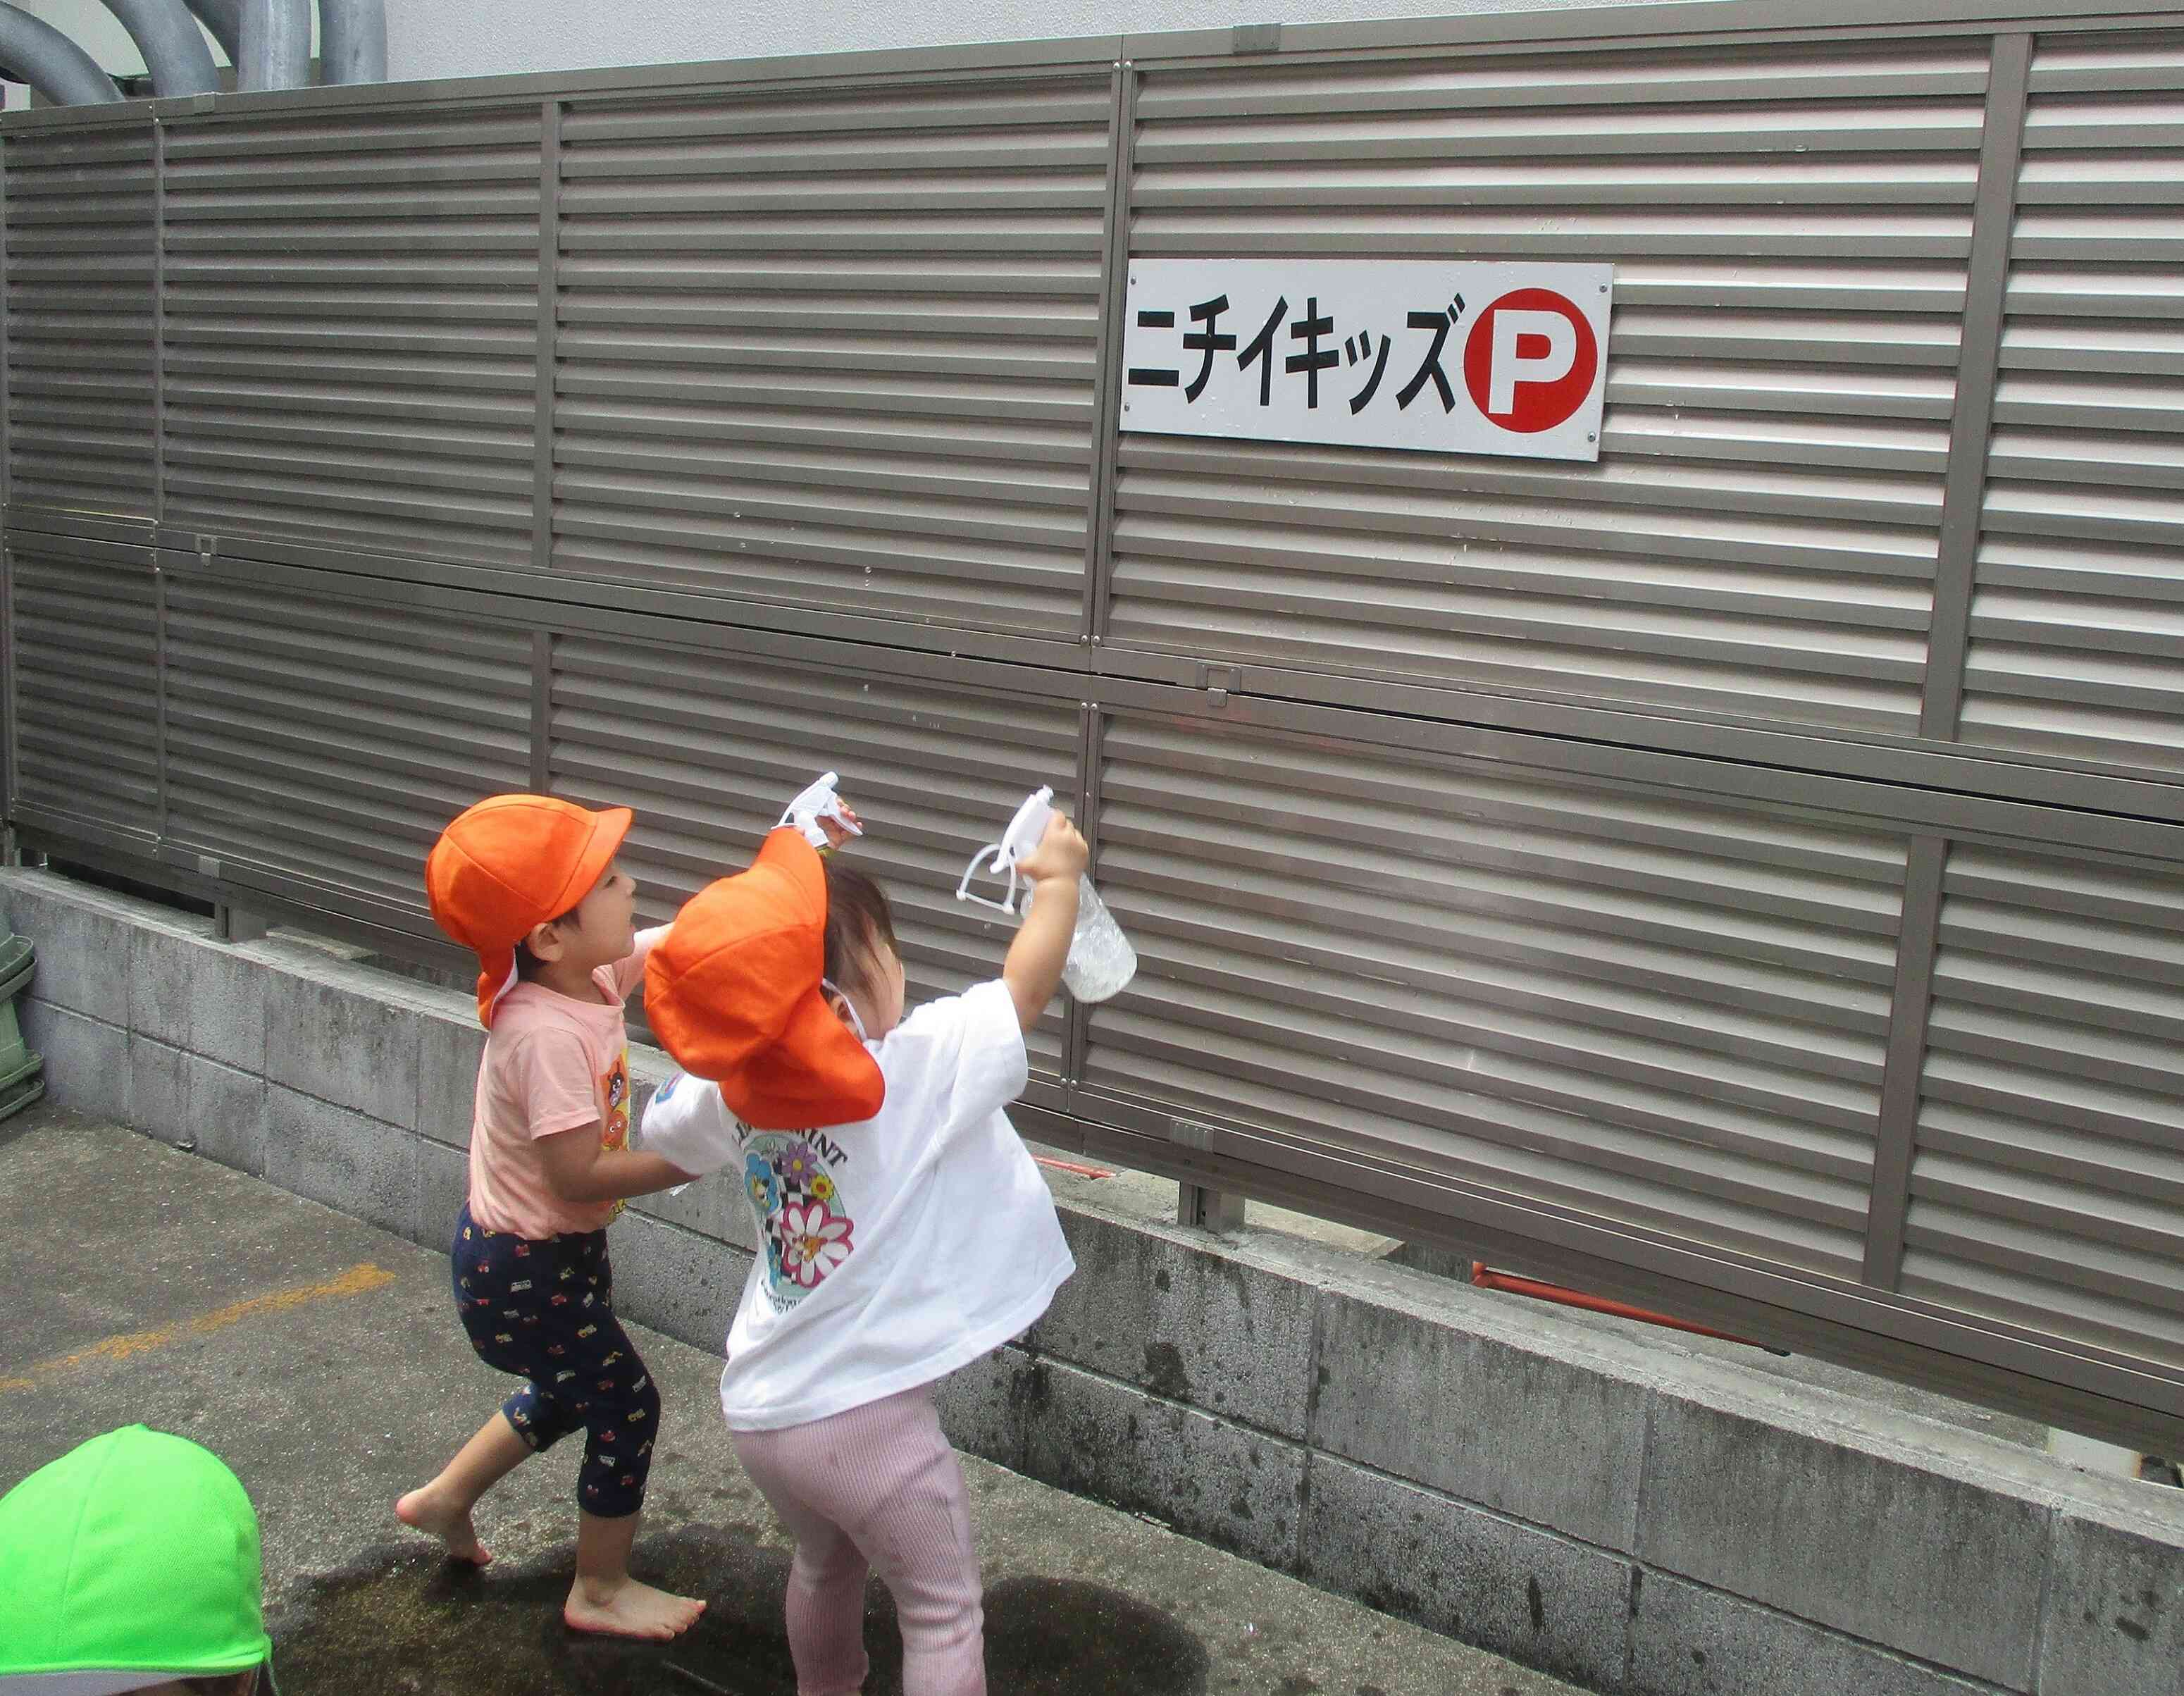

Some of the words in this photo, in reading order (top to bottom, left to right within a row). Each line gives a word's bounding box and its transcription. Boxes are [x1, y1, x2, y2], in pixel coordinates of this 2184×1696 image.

[1127, 292, 1466, 415] ニチイキッズ
[1488, 309, 1577, 416] P
[800, 1127, 848, 1167] INT
